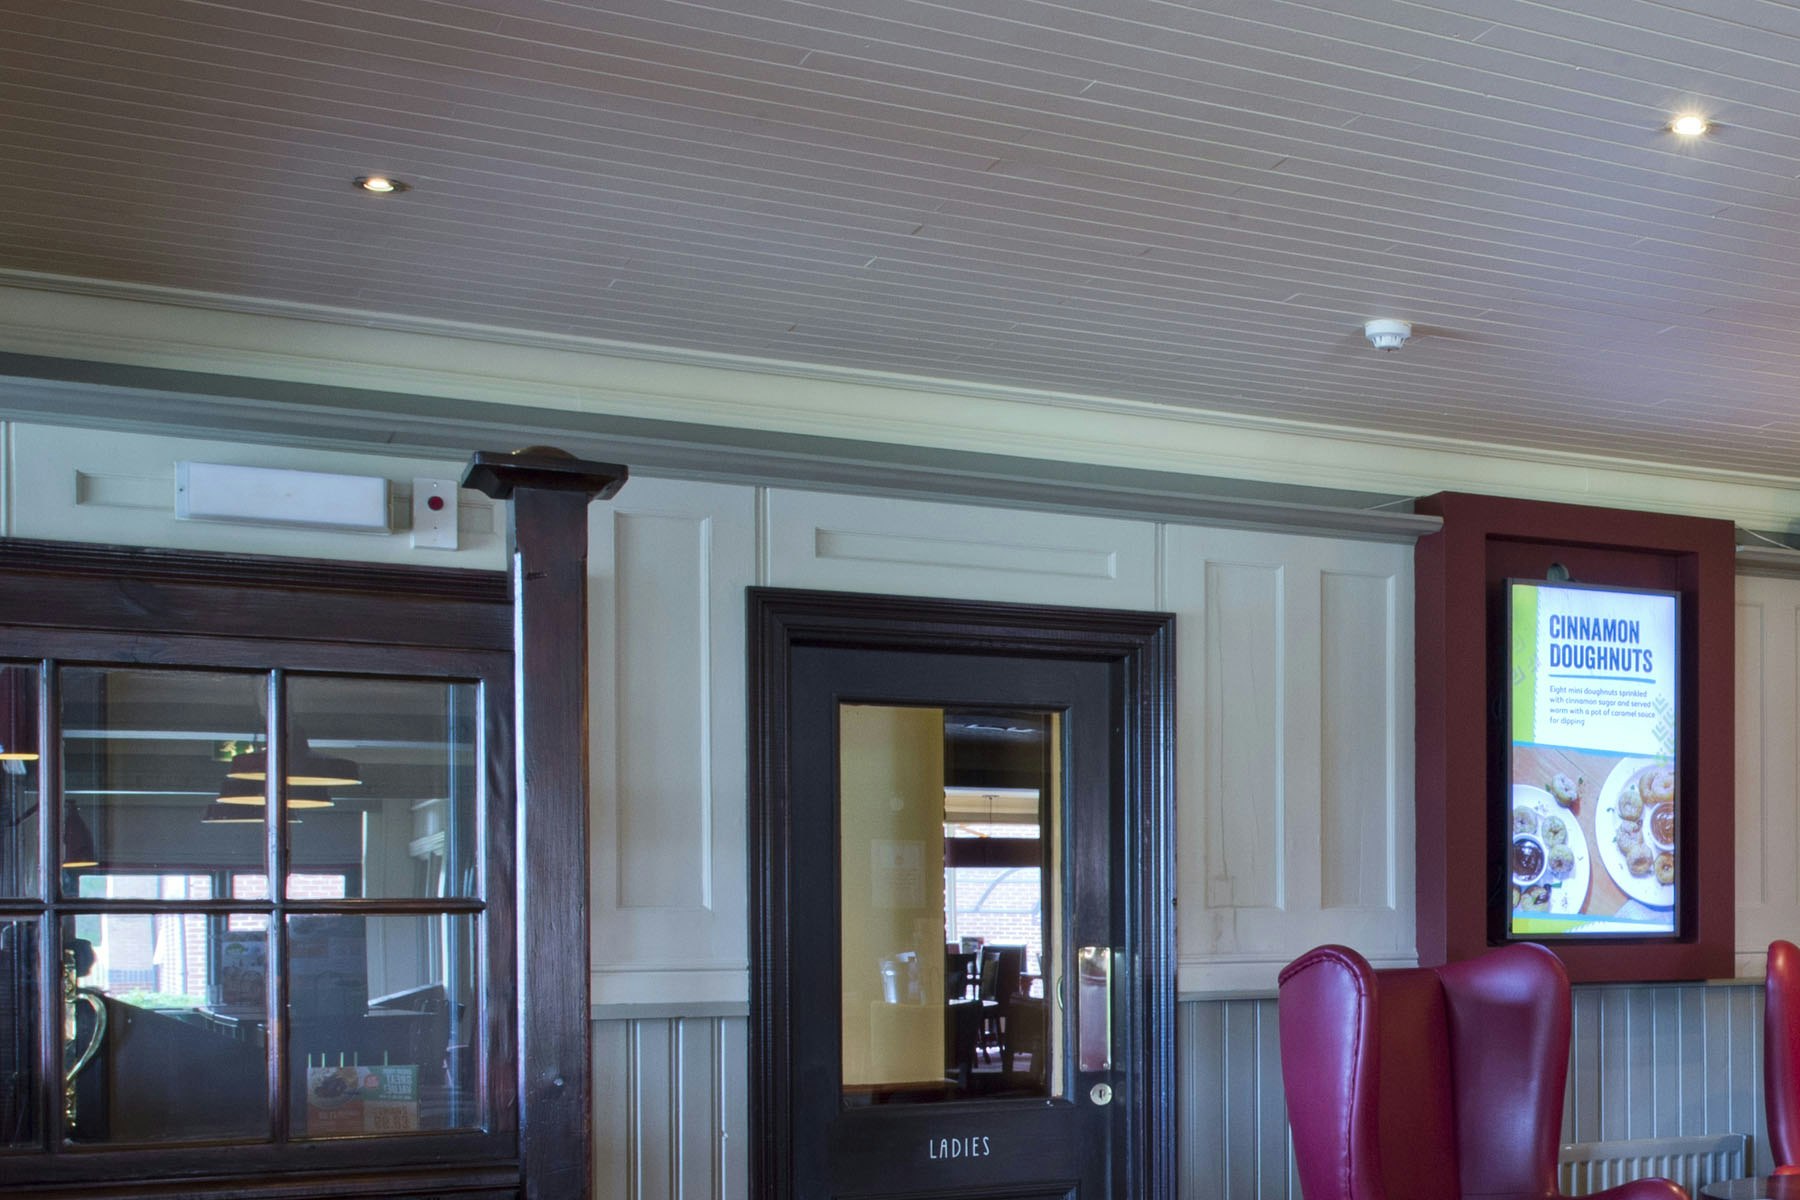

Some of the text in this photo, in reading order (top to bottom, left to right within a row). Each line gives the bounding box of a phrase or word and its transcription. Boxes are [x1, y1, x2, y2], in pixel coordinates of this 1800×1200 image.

[1549, 614, 1640, 644] CINNAMON
[1550, 643, 1653, 673] DOUGHNUTS
[1549, 685, 1567, 694] Eight
[1583, 688, 1618, 697] doughnuts
[1619, 689, 1648, 698] sprinkled
[1565, 697, 1597, 705] cinnamon
[1598, 699, 1616, 707] sugar
[1570, 707, 1583, 715] with
[1590, 708, 1602, 717] pot
[1603, 708, 1610, 716] of
[1611, 710, 1637, 718] caramel
[1638, 711, 1655, 719] sauce
[1549, 716, 1585, 726] for dipping
[930, 1136, 990, 1159] LADIES
